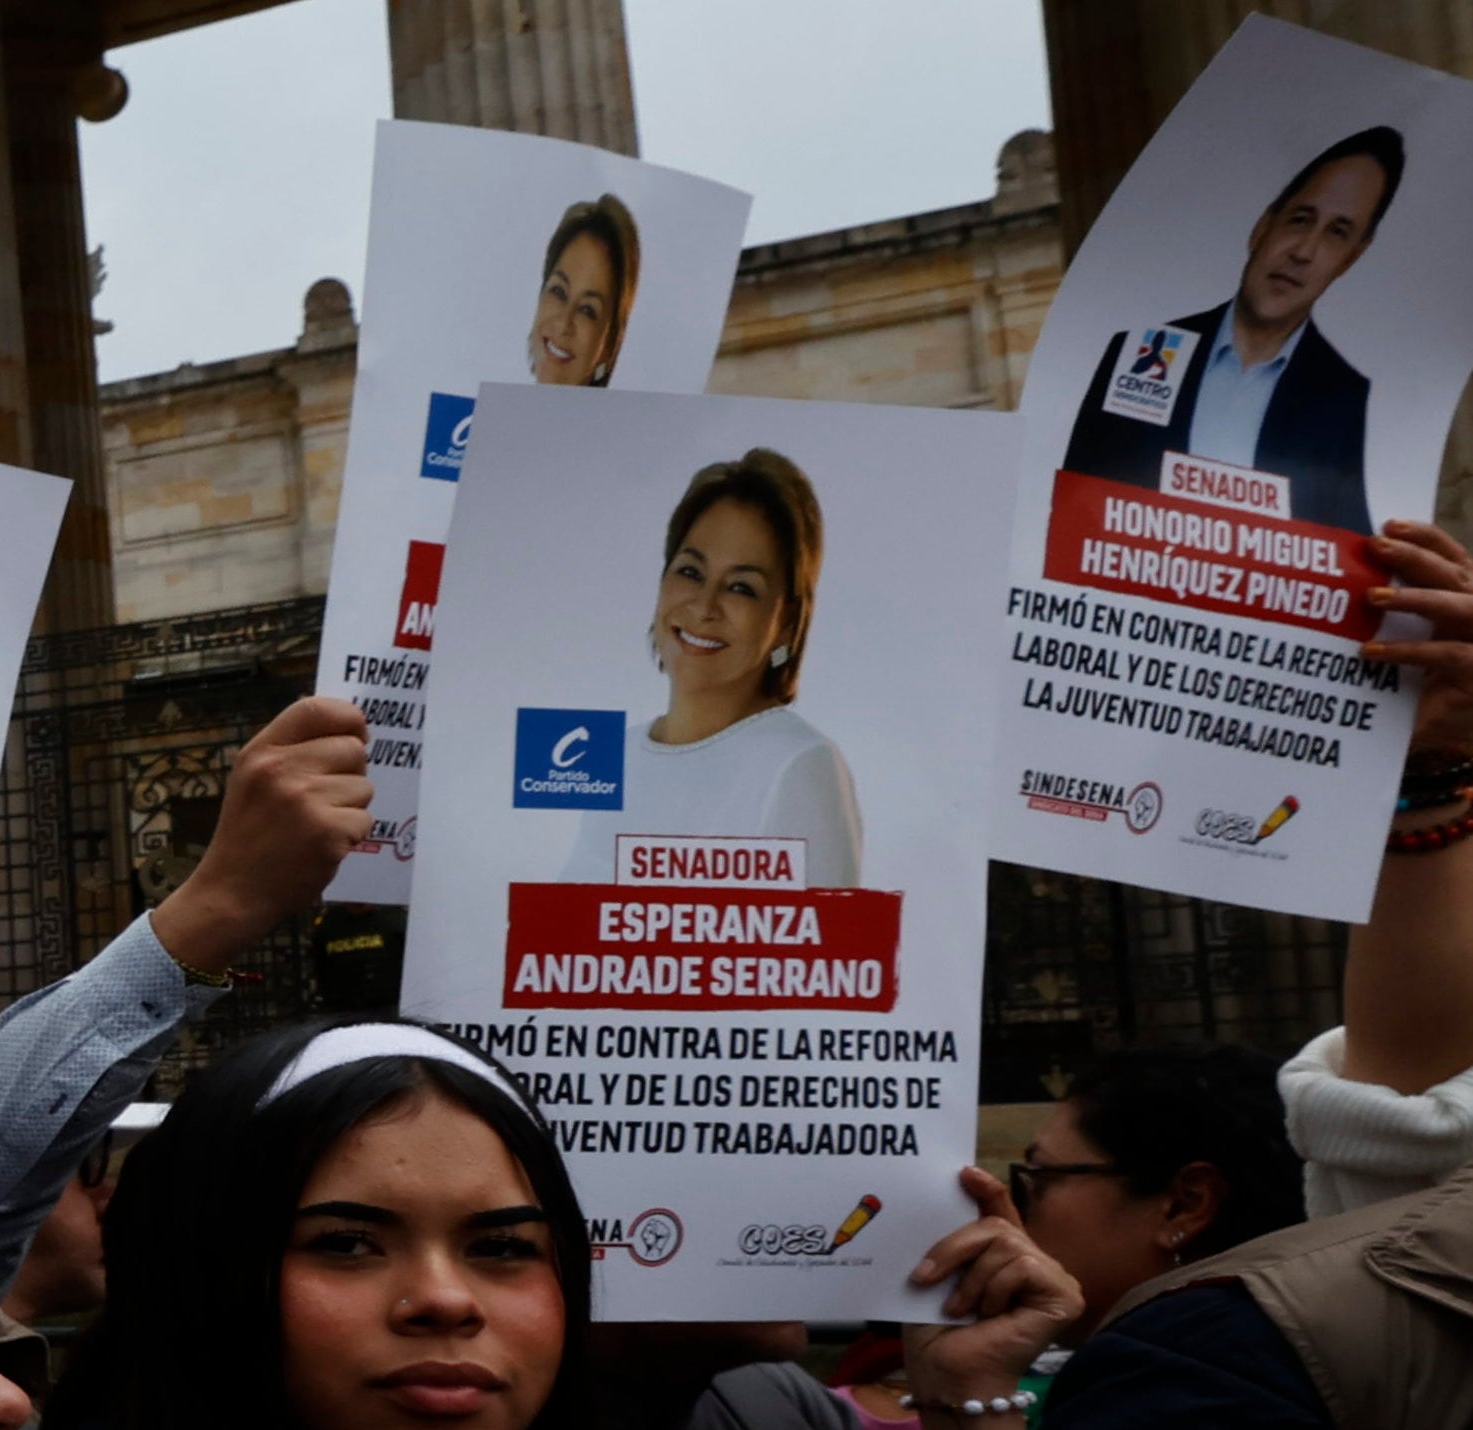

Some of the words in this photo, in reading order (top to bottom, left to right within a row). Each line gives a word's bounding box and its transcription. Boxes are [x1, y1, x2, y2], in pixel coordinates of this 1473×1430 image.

[1116, 374, 1173, 400] CENTRO
[1170, 462, 1280, 511] SENADOR
[1103, 497, 1232, 554] HONORIO
[1237, 523, 1345, 577] MIGUEL
[1080, 538, 1243, 600] HENRÍQUEZ
[1246, 572, 1350, 624] PINEDO
[1007, 587, 1087, 630] FIRMÓ
[1091, 603, 1126, 638] EN
[1128, 609, 1222, 663] CONTRA
[1226, 633, 1258, 663] DE
[1258, 637, 1287, 671] LA
[1288, 643, 1402, 693] REFORMA
[344, 653, 404, 689] FIRMÓ
[403, 662, 430, 691] EN
[1011, 631, 1120, 681] LABORAL
[1127, 653, 1142, 683] Y
[1145, 657, 1179, 690] DE
[1179, 667, 1222, 701] LOS
[1223, 675, 1335, 727] DERECHOS
[1340, 700, 1377, 732] DE
[1022, 677, 1054, 712] LA
[1056, 685, 1182, 736] JUVENTUD
[1186, 709, 1342, 769] TRABAJADORA
[520, 777, 617, 794] Conservador
[548, 769, 590, 782] Partido
[1020, 769, 1126, 808] SINDESENA
[631, 845, 794, 882] SENADORA
[598, 901, 822, 946] ESPERANZA
[512, 953, 704, 997] ANDRADE
[708, 956, 883, 1000] SERRANO
[546, 1025, 592, 1058] EN
[596, 1025, 720, 1061] CONTRA
[729, 1026, 769, 1061] DE
[776, 1028, 816, 1061] LA
[818, 1029, 958, 1063] REFORMA
[599, 1073, 621, 1106] Y
[625, 1074, 668, 1108] DE
[674, 1074, 732, 1109] LOS
[740, 1075, 898, 1110] DERECHOS
[907, 1077, 941, 1110] DE
[694, 1121, 919, 1157] TRABAJADORA
